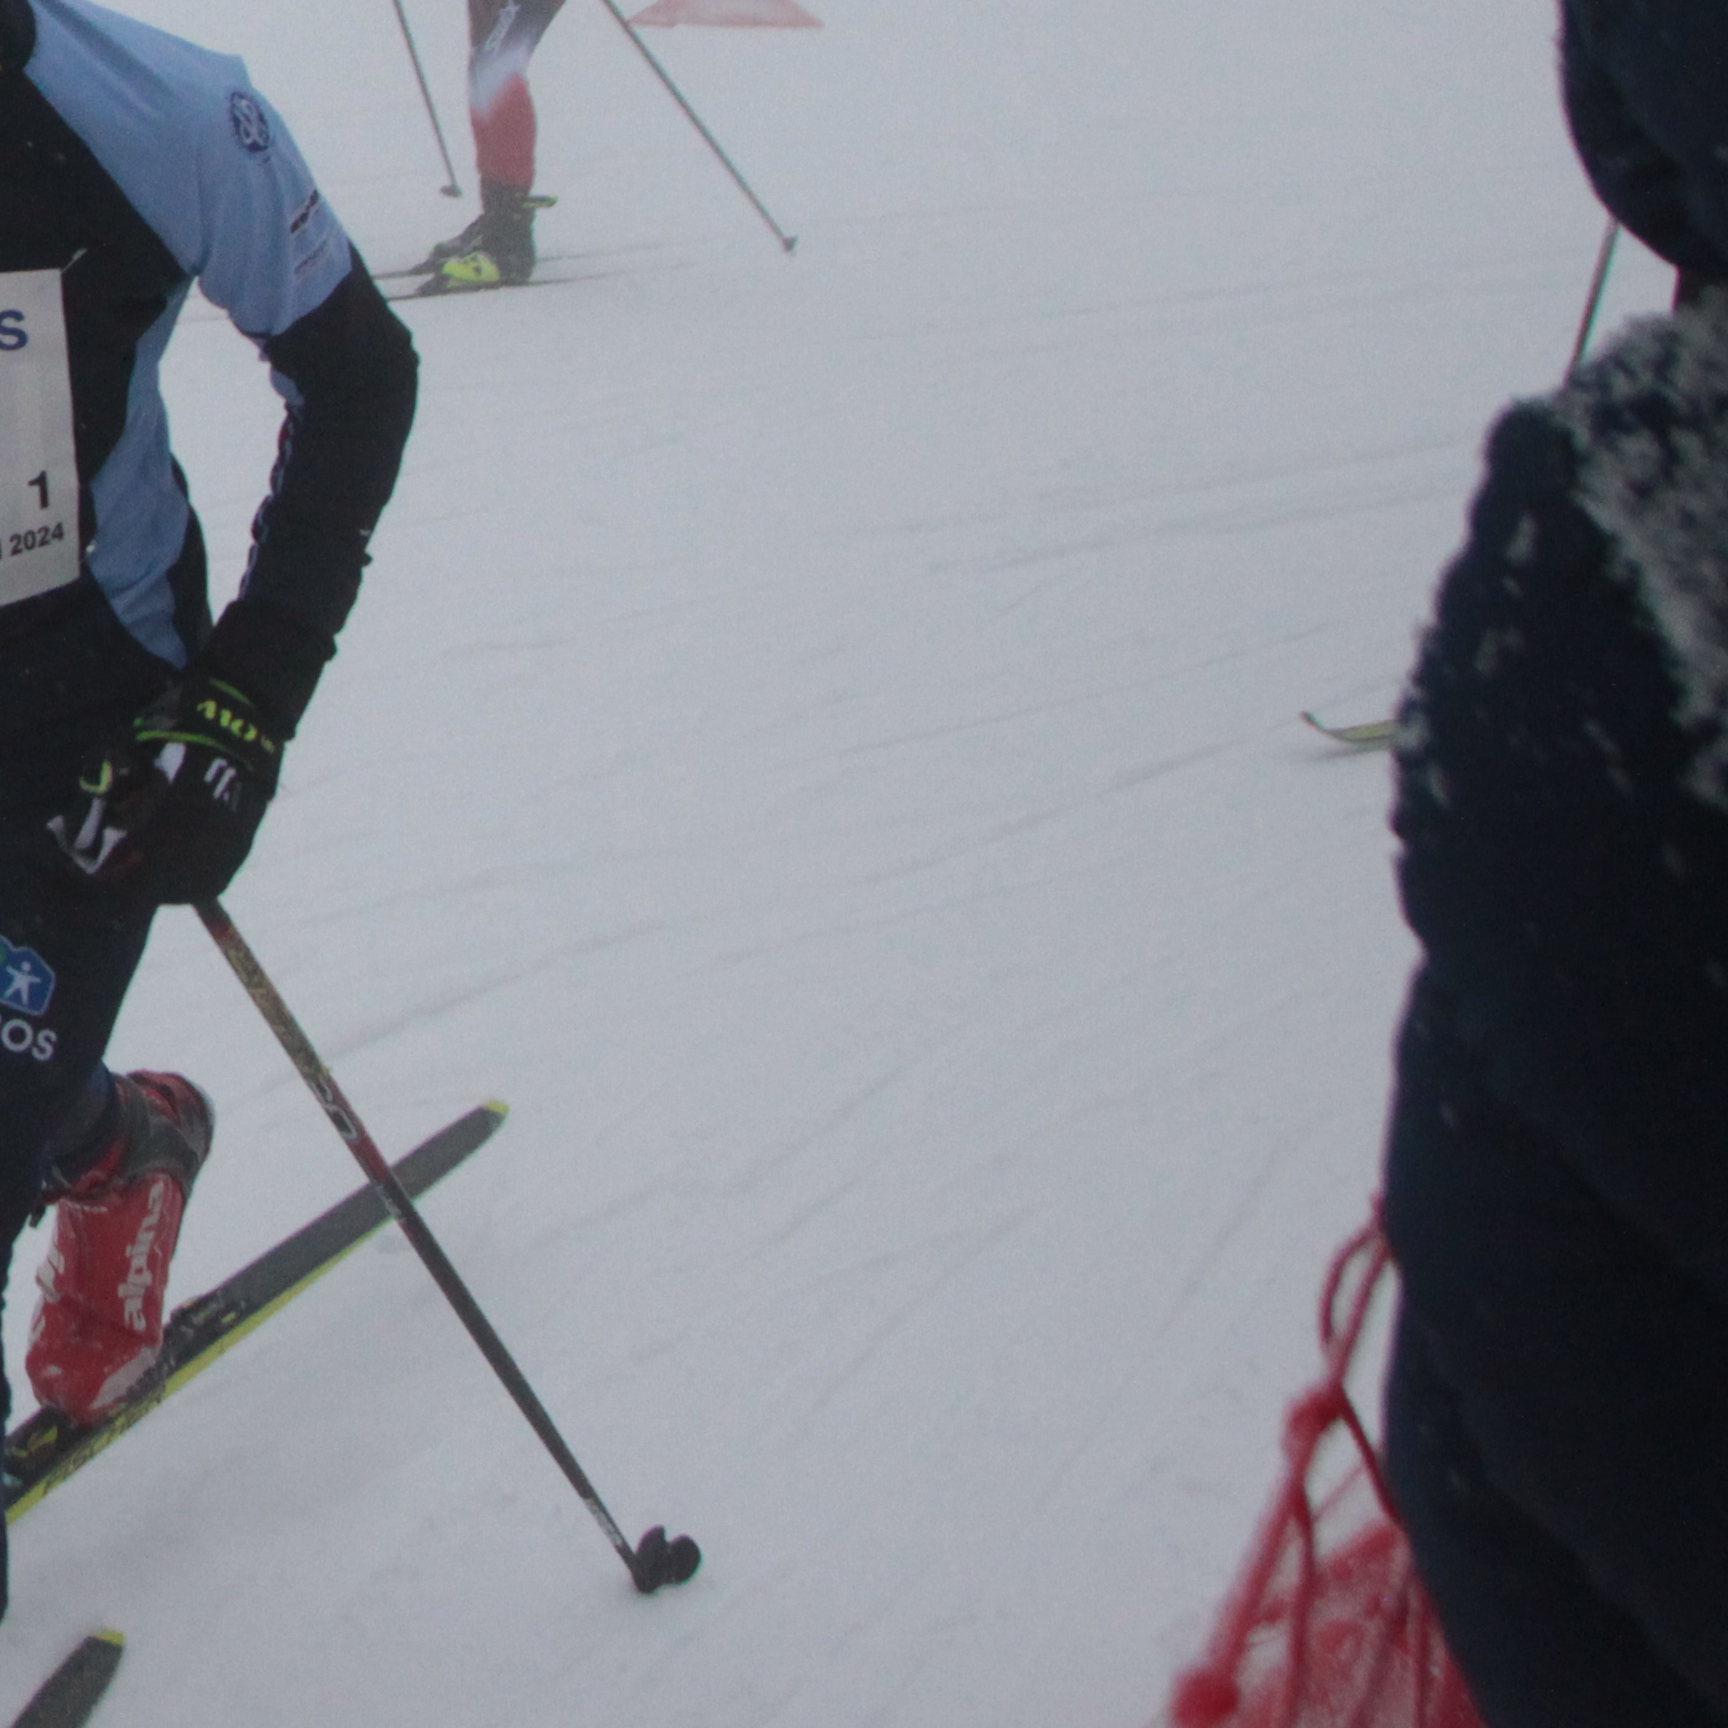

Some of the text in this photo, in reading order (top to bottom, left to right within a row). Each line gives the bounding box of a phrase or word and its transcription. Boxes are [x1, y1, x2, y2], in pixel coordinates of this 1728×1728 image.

[28, 470, 50, 509] 1
[8, 522, 65, 557] 2024
[117, 1180, 165, 1330] alpina
